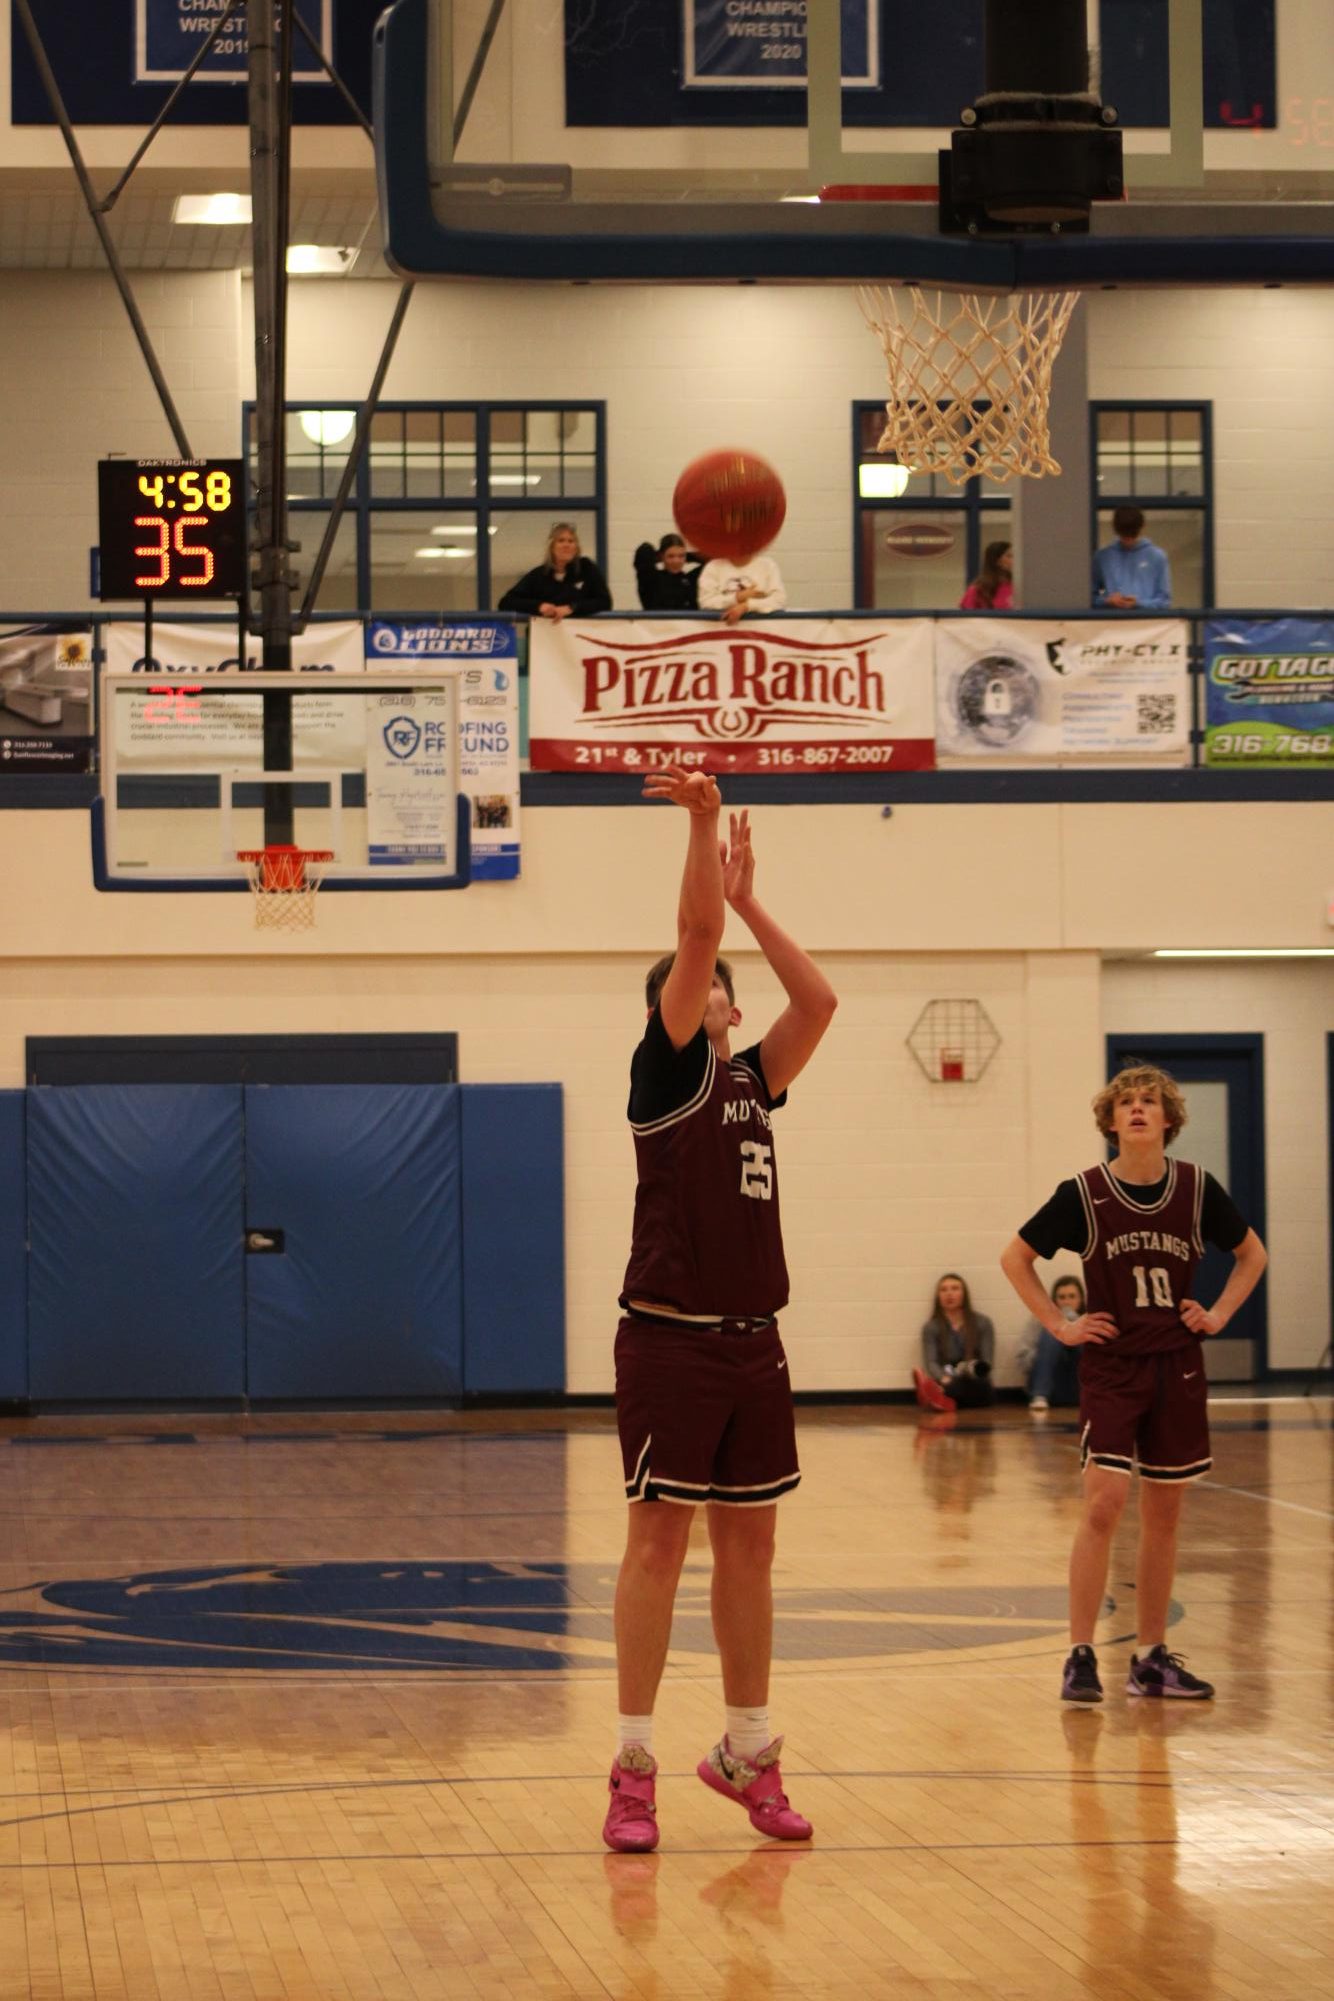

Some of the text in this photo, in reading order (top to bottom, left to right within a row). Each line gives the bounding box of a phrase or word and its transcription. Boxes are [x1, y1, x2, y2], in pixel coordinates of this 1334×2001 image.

[726, 1, 808, 16] CHAMPIO
[761, 43, 803, 60] 2020
[138, 471, 232, 512] 4:58
[133, 516, 215, 586] 35
[399, 640, 491, 652] LIONS
[402, 627, 493, 640] GODDARD
[581, 644, 887, 713] Pizza Ranch
[574, 746, 895, 768] 21st & Tyler 316-867-2007
[1105, 1231, 1190, 1262] MUSTANGS
[1132, 1265, 1175, 1308] 10
